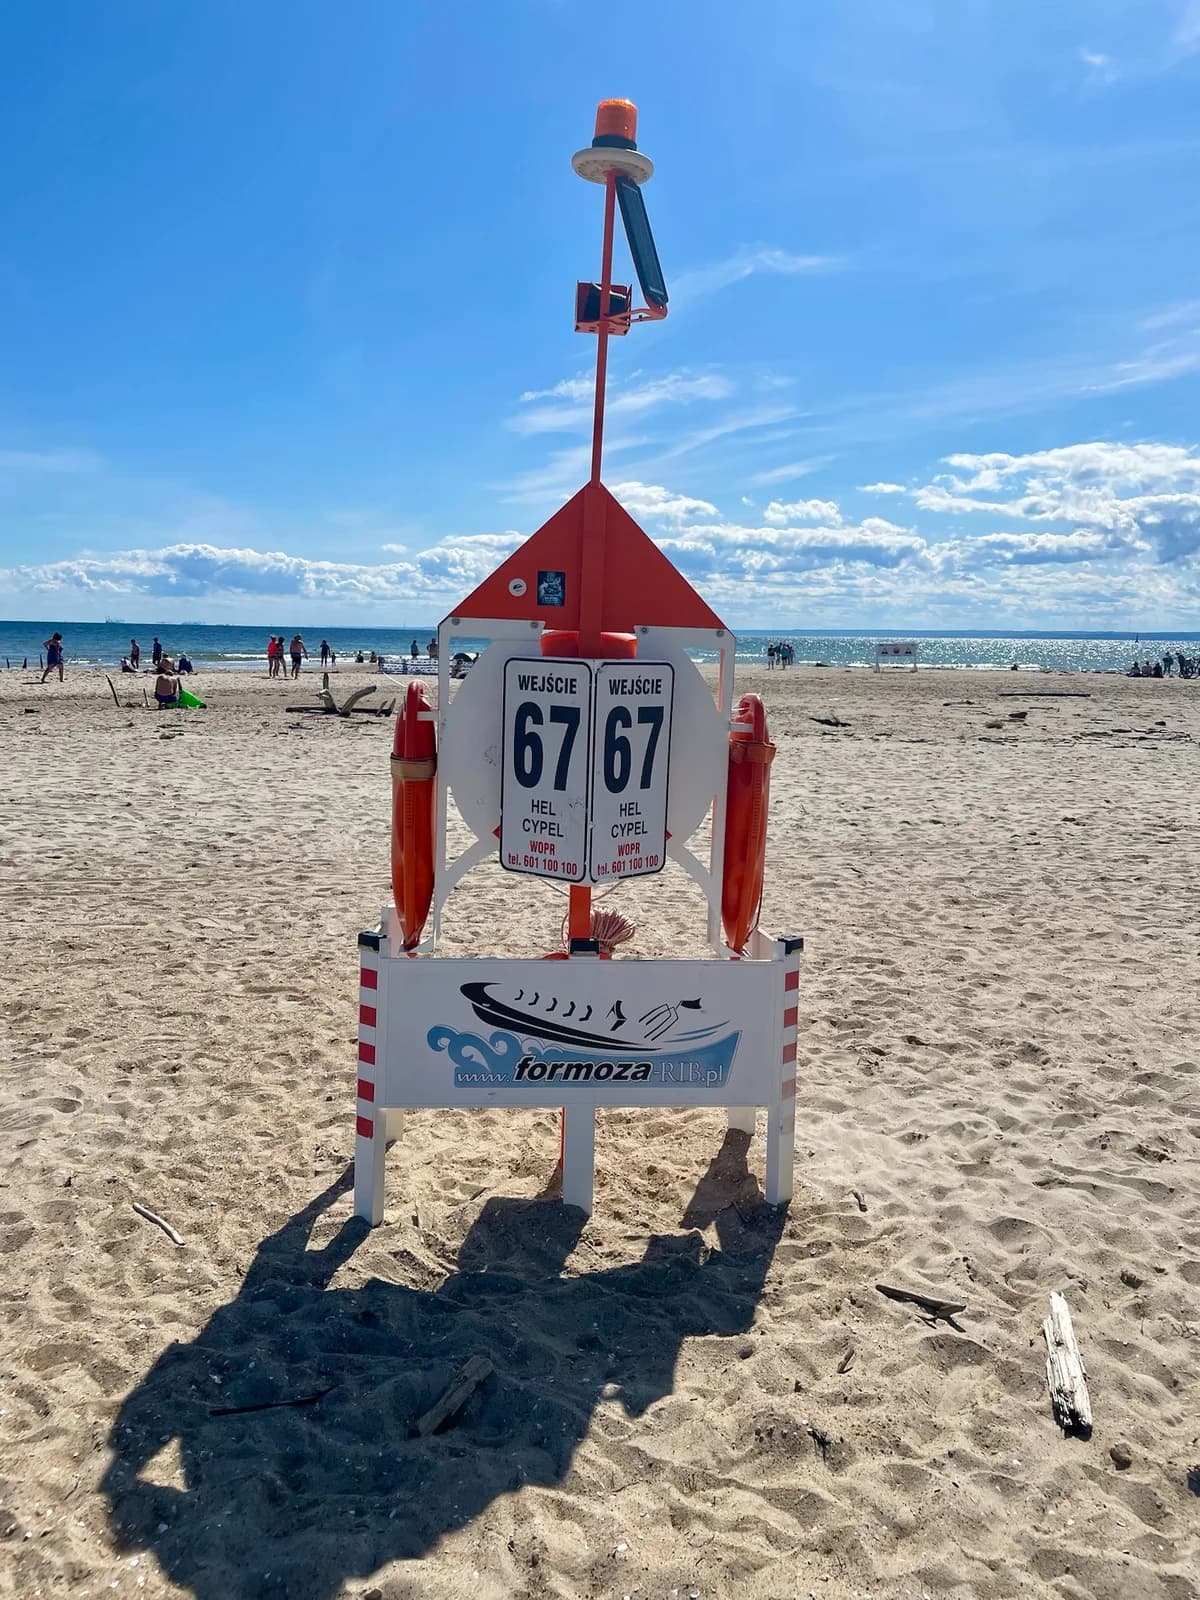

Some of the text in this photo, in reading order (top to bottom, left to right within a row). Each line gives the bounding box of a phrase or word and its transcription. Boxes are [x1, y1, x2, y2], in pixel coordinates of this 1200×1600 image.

[518, 673, 577, 694] WEJŚCIE
[609, 675, 662, 695] WEJŚCIE
[513, 701, 581, 791] 67
[603, 705, 665, 793] 67
[531, 799, 556, 816] HEL
[619, 802, 642, 817] HEL
[522, 818, 564, 838] CYPEL
[611, 821, 648, 839] CYPEL
[530, 840, 556, 855] WOPR
[617, 842, 641, 857] WOPR
[508, 853, 578, 876] tel. 601 100 100
[597, 855, 659, 876] tel. 601 100 100
